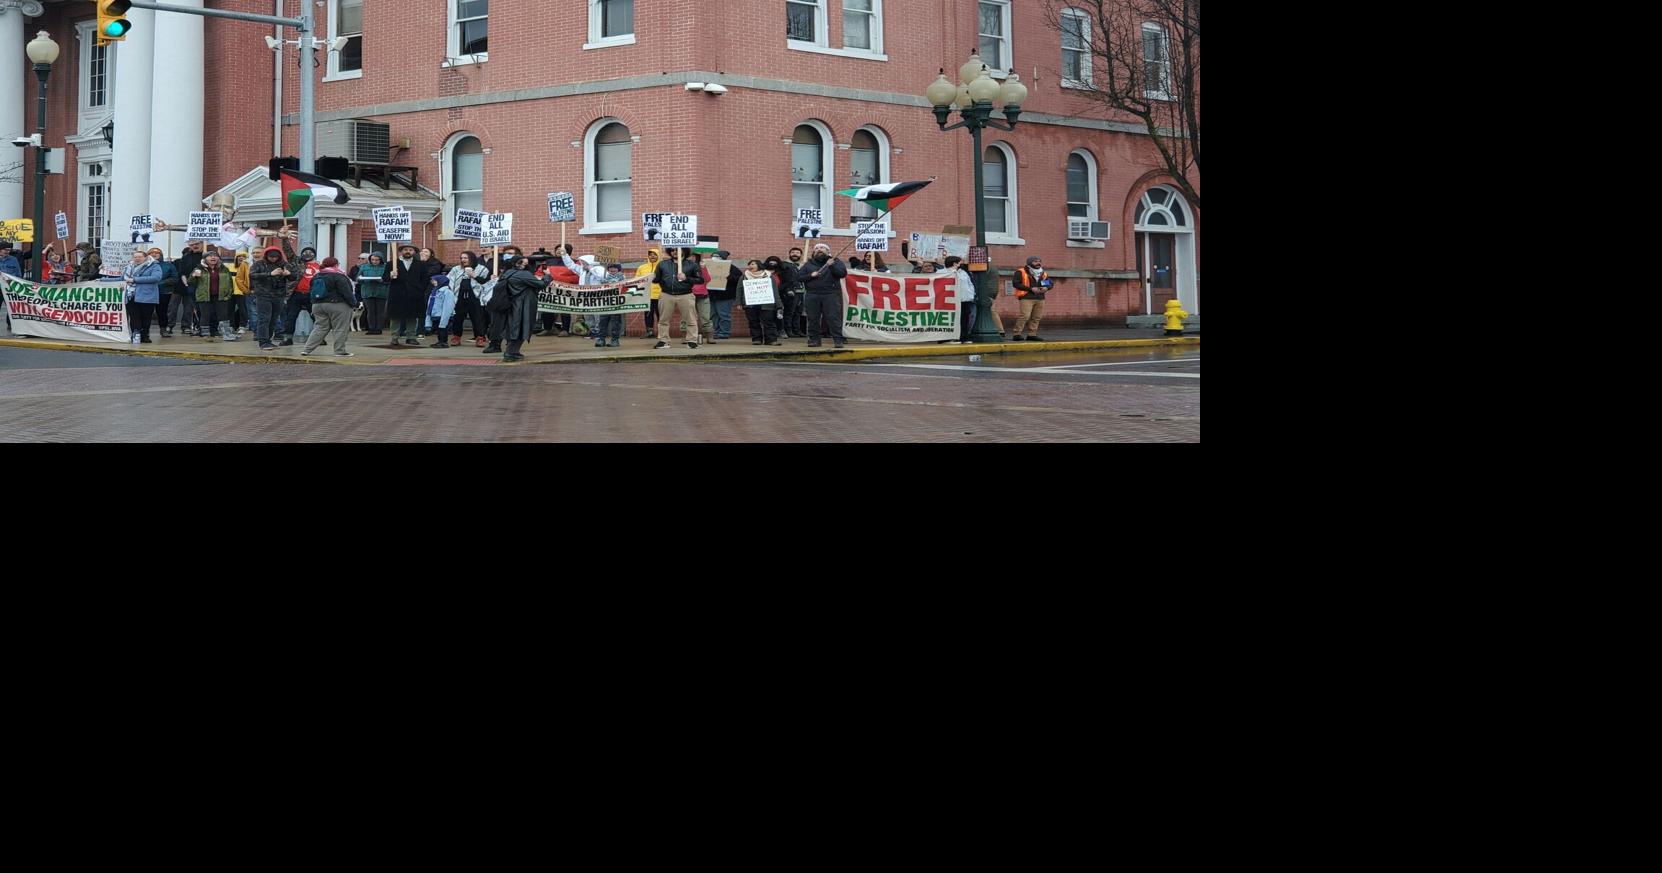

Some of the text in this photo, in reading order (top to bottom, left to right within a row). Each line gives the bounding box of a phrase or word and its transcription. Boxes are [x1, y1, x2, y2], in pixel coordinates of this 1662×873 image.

[549, 197, 573, 212] FREE
[488, 213, 505, 222] END
[644, 213, 672, 223] FRE
[800, 209, 821, 219] FREE
[131, 215, 151, 225] FREE
[379, 218, 409, 226] RAFAH!
[670, 215, 689, 224] END
[489, 222, 503, 230] ALL
[671, 223, 687, 231] ALL
[482, 230, 496, 238] U.S.
[857, 242, 886, 250] RAFAH!
[5, 280, 124, 303] JOE MANCHIN
[556, 288, 574, 298] U.S.
[577, 287, 620, 298] FUNDING
[845, 274, 956, 311] FREE
[539, 293, 626, 308] RAELI APARTHEID
[60, 302, 102, 311] CHARGE
[105, 303, 123, 312] YOU
[42, 307, 123, 325] GENOCIDE!
[846, 306, 955, 327] PALESTINE!
